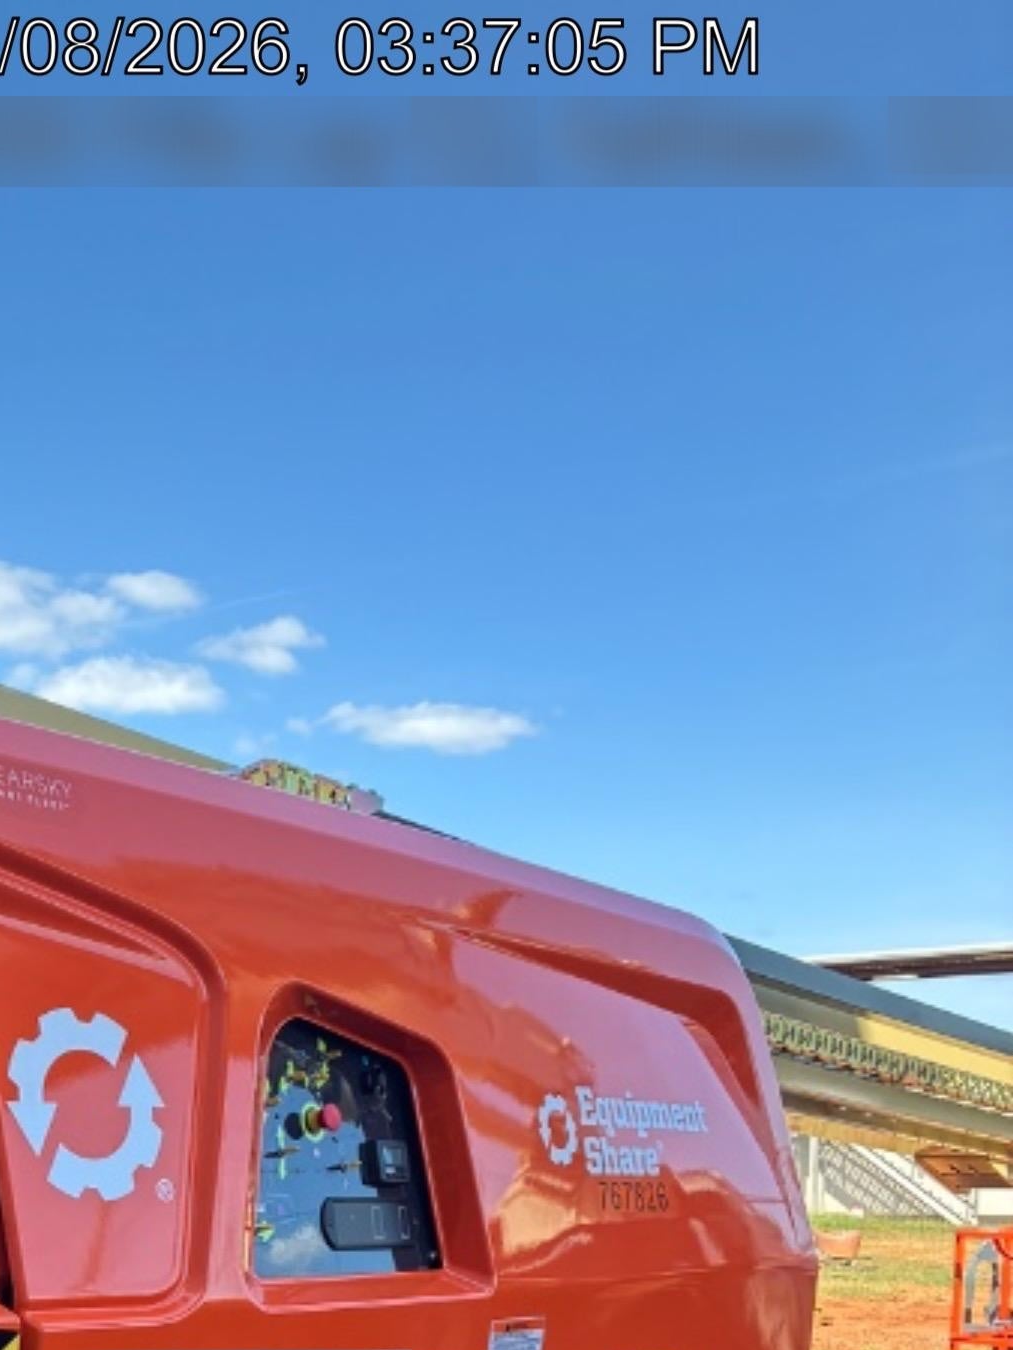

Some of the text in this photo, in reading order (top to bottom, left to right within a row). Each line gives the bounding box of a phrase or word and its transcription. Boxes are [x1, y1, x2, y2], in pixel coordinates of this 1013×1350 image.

[575, 1085, 708, 1138] Equipment
[584, 1136, 660, 1176] Share
[599, 1180, 669, 1213] 767826
